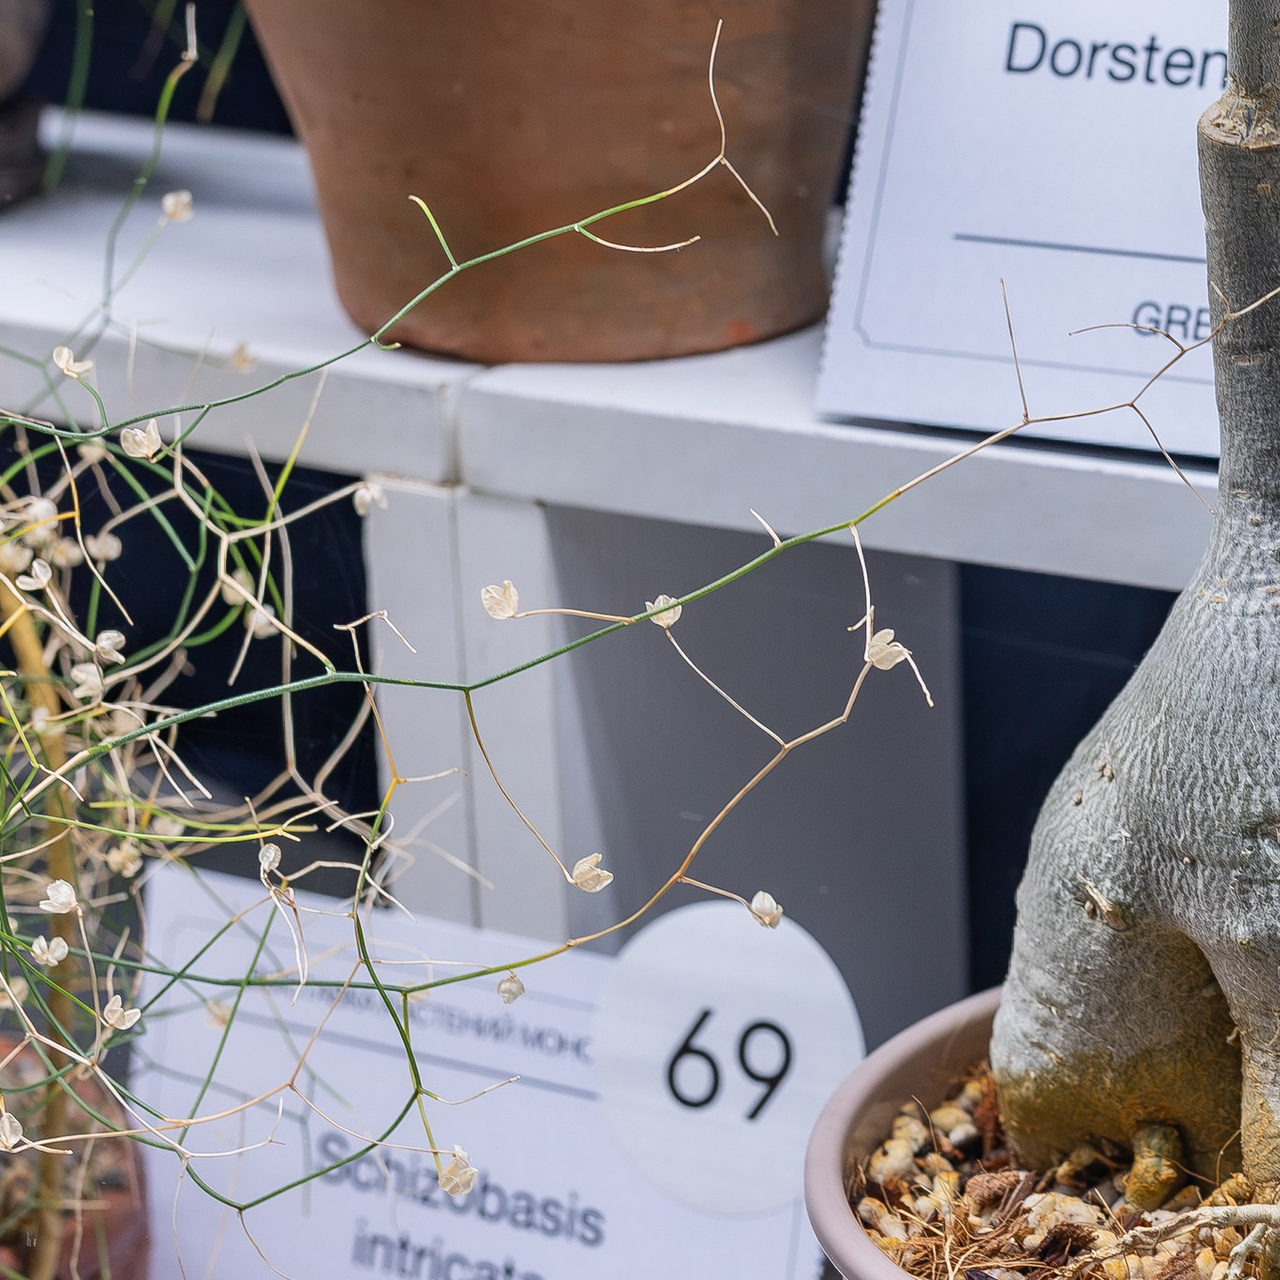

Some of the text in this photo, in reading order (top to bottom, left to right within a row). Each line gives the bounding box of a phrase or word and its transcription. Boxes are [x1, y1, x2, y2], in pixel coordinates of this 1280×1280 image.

[1005, 22, 1228, 89] Dorsten
[666, 1007, 793, 1122] 69
[315, 1129, 606, 1248] Schizobasis
